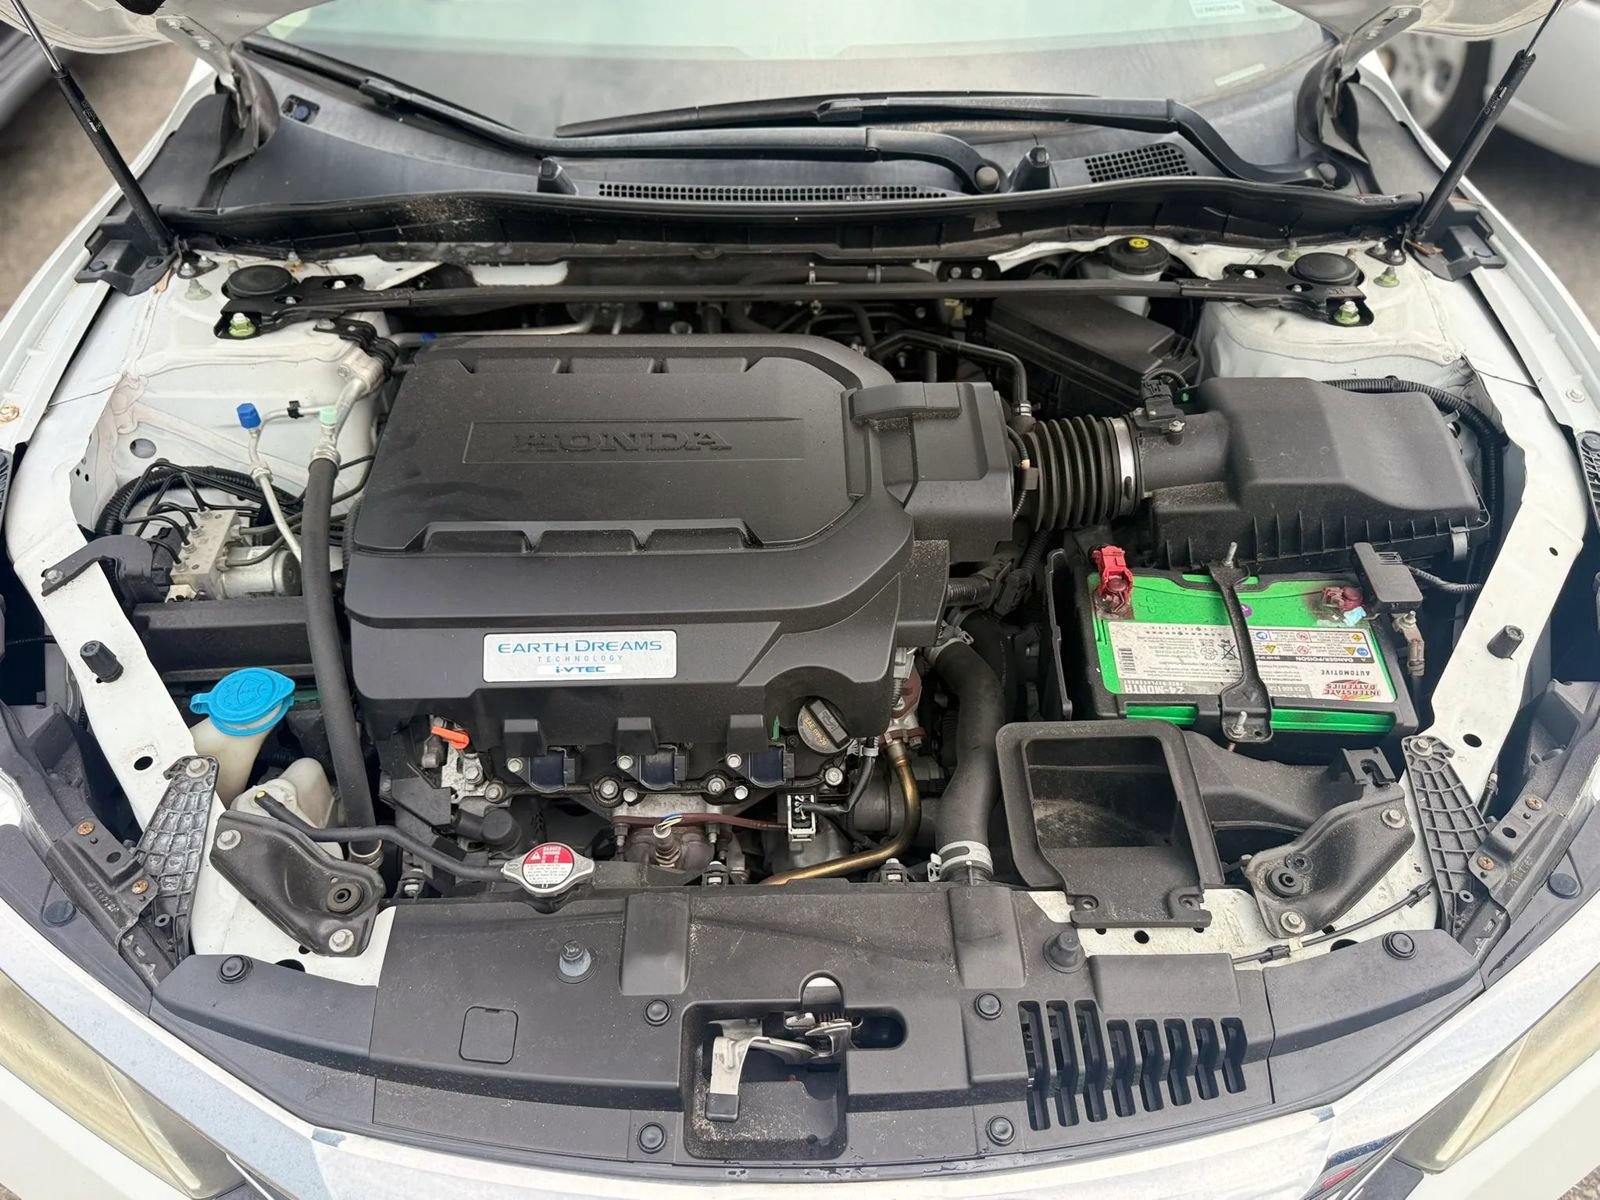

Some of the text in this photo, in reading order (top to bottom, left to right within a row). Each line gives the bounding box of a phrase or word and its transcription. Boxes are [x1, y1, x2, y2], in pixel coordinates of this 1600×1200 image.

[512, 430, 733, 453] HONDA
[498, 638, 663, 654] EARTH DREAMS
[537, 655, 624, 663] TECHNOLOGY
[555, 665, 606, 673] i-VTEC
[1320, 669, 1371, 677] AUTOMOTIVE
[1124, 685, 1185, 695] 24-MONTH
[1322, 689, 1381, 697] INTERSTATE
